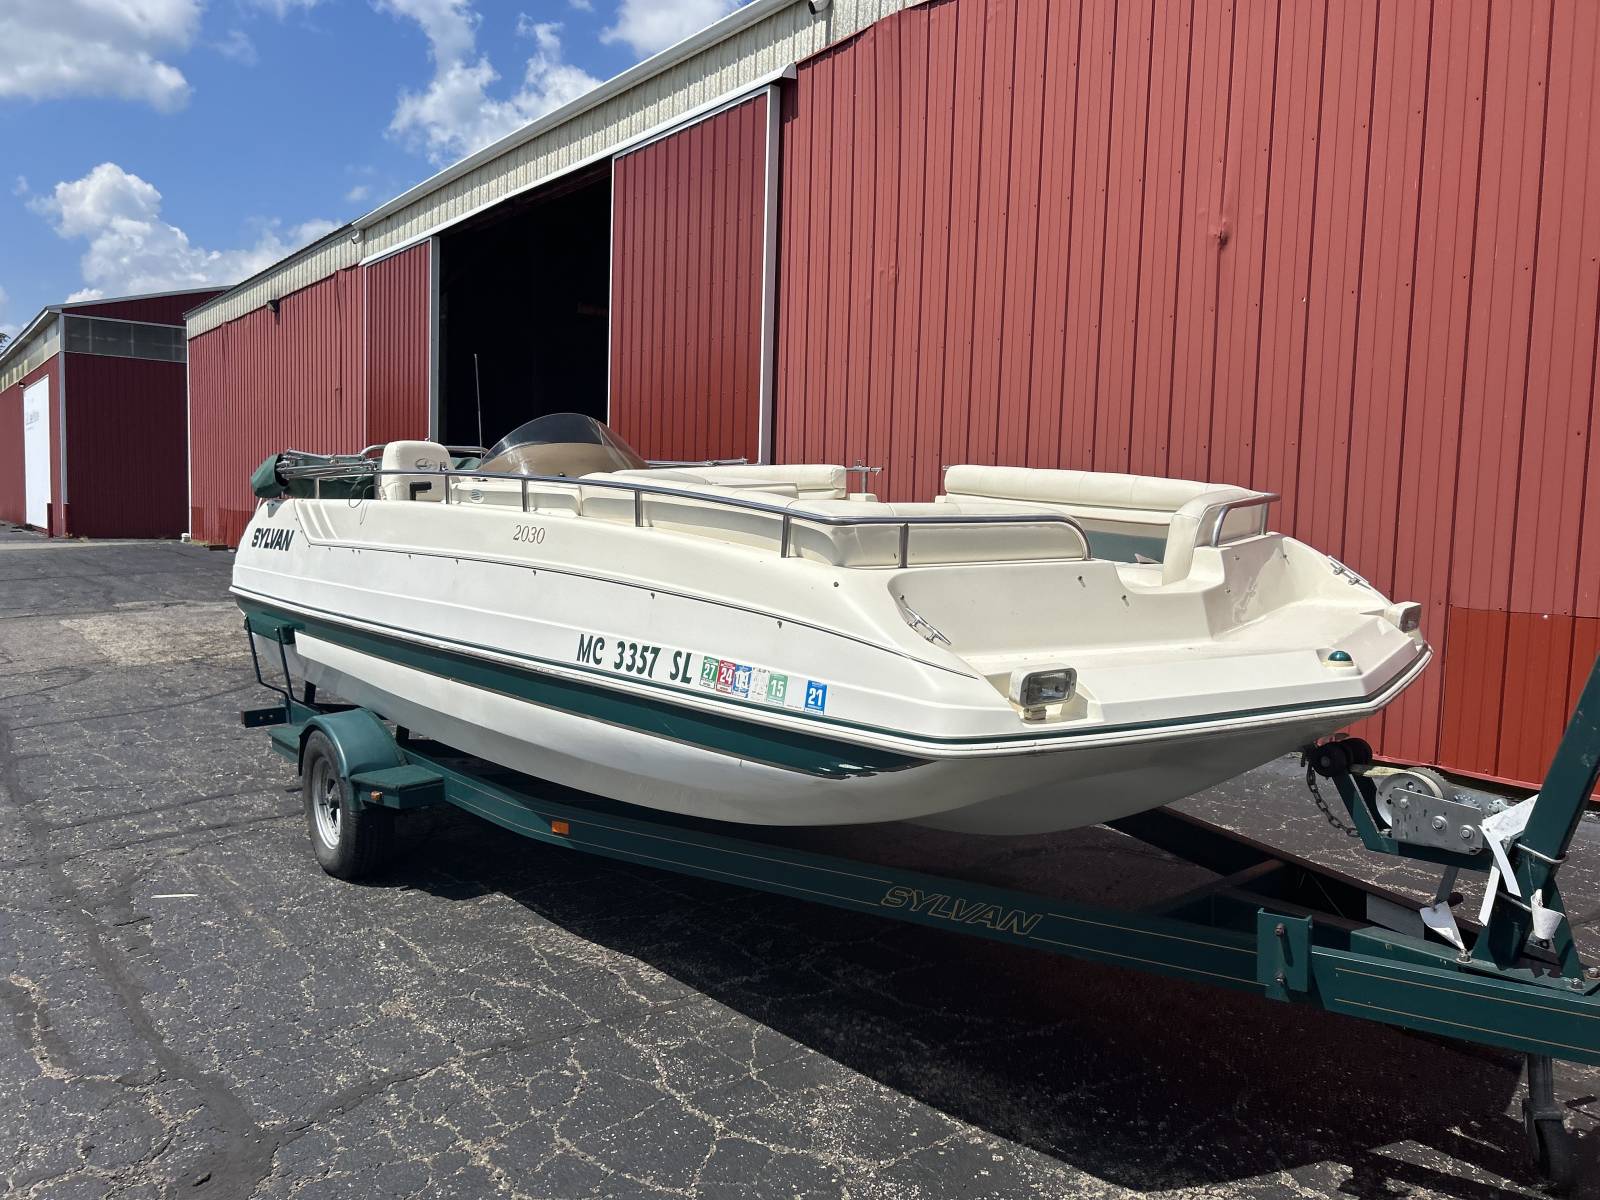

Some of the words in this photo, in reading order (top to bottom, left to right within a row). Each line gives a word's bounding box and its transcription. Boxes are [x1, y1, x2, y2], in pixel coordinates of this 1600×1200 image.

[251, 528, 295, 552] SYLVAN
[512, 524, 546, 545] 2030
[576, 633, 605, 665] MC
[613, 640, 662, 679] 3357
[669, 650, 693, 685] SL
[702, 663, 716, 680] 27
[719, 667, 733, 685] 24
[770, 679, 785, 698] 15
[807, 687, 823, 707] 21
[880, 886, 1044, 935] SYLVAN
